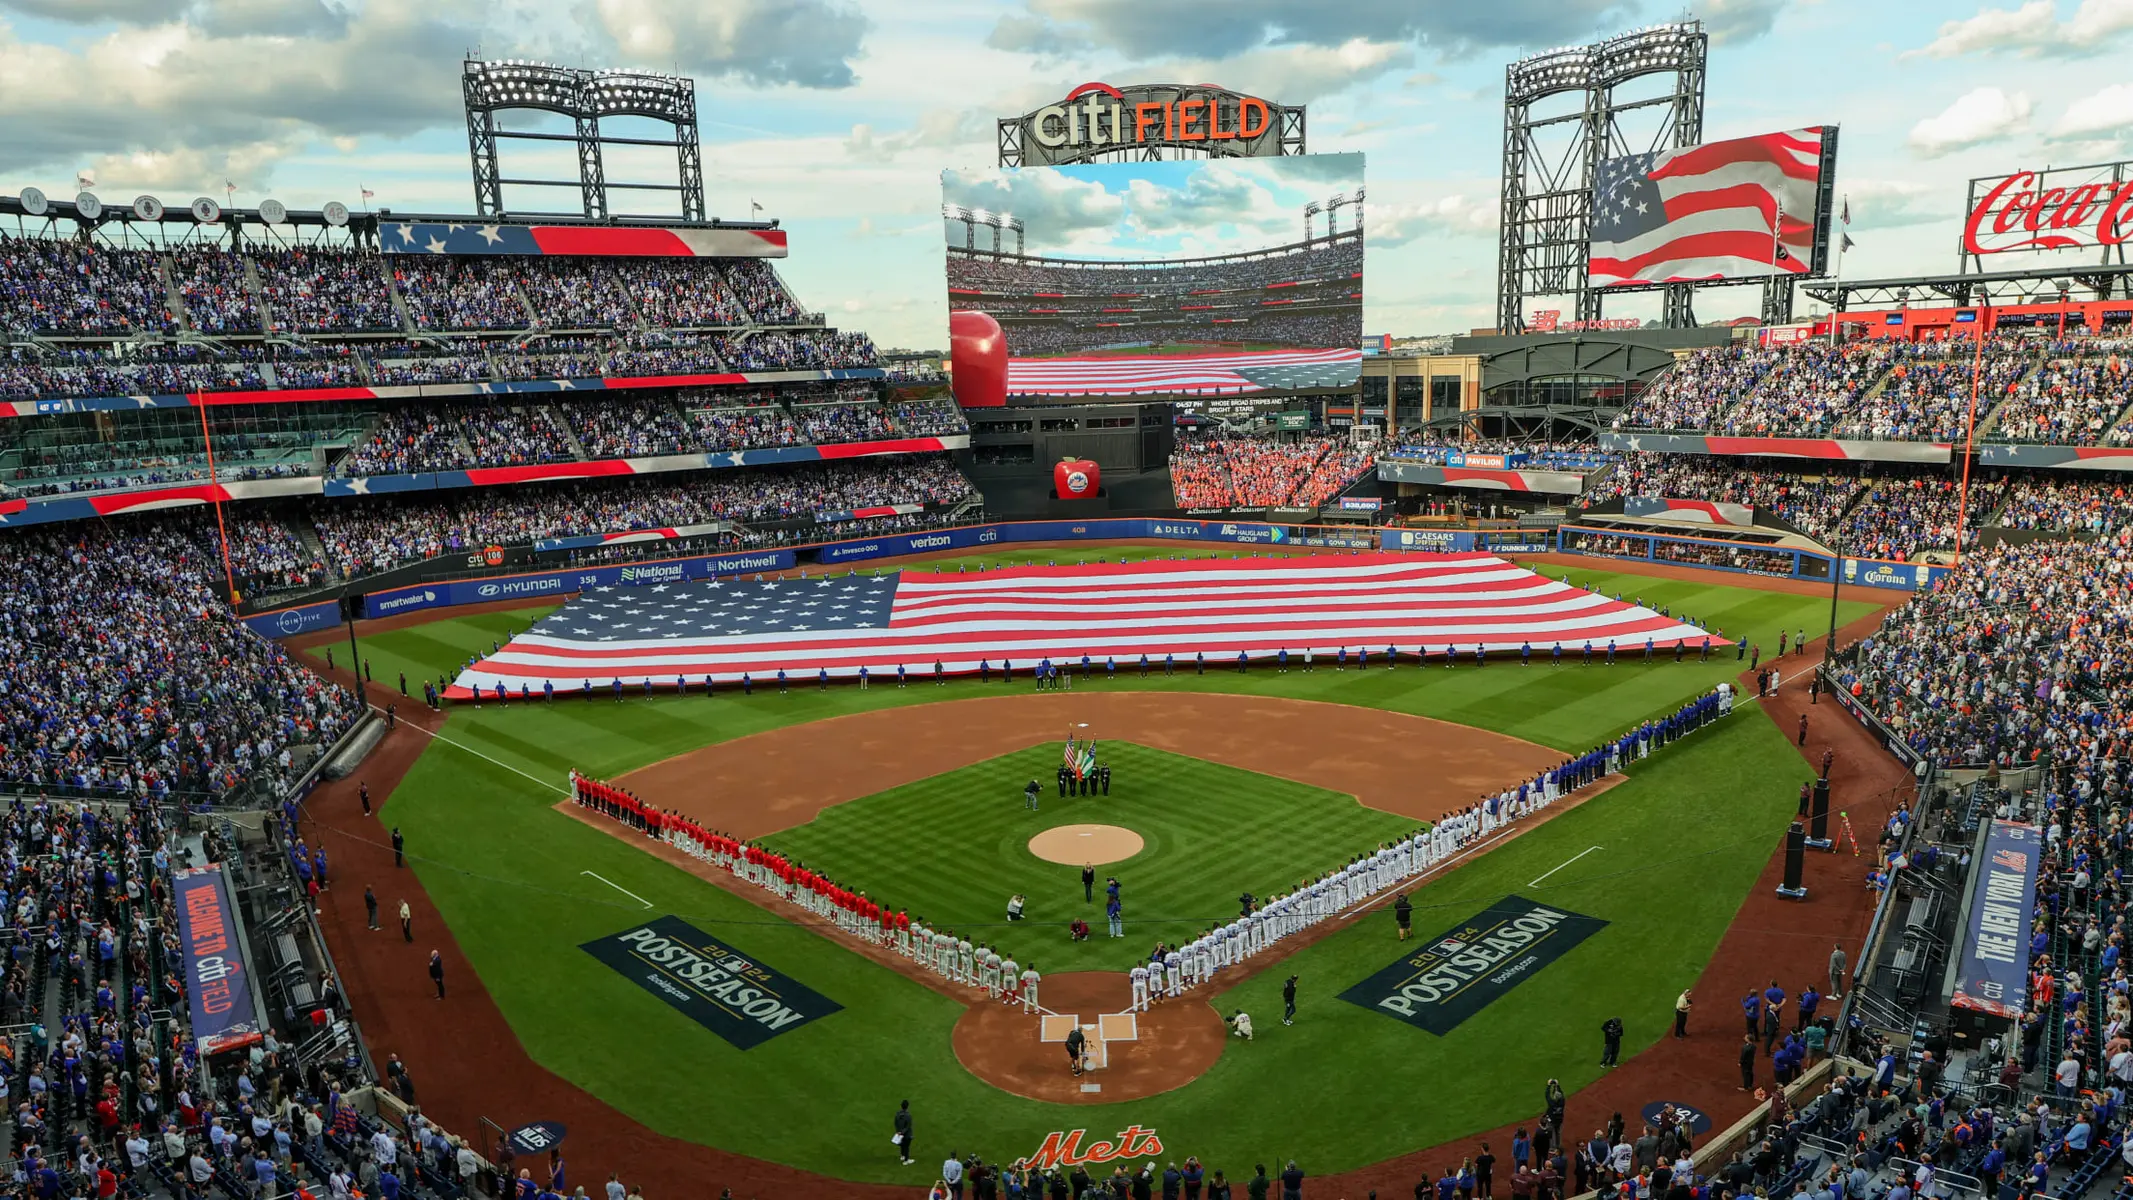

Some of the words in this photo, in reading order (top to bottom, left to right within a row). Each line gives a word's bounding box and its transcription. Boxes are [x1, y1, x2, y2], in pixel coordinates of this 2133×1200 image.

[1034, 93, 1121, 147] citi
[1135, 97, 1269, 143] FIELD
[27, 194, 40, 207] 14
[82, 199, 95, 211] 37
[262, 205, 283, 217] SHEA
[328, 207, 344, 219] 42
[1964, 171, 2133, 255] Coca-C
[1588, 317, 1640, 330] balance
[1450, 456, 1463, 464] citi
[1467, 457, 1501, 466] PAVILION
[979, 531, 997, 542] citi
[1165, 525, 1199, 535] DELTA
[1237, 529, 1269, 537] HAUGLAND
[1415, 532, 1454, 541] CAESARS
[911, 535, 951, 549] verizon
[1289, 537, 1301, 545] 380
[842, 546, 865, 555] Invesco
[1583, 551, 1616, 560] CADILLAC
[468, 554, 483, 563] citi
[718, 554, 777, 571] Northwell
[635, 564, 682, 579] National
[1747, 569, 1788, 579] CADILLAC
[1864, 570, 1906, 584] Corona
[503, 578, 561, 593] HYUNDAI
[580, 576, 597, 584] 358
[379, 594, 424, 610] smartwater
[1985, 870, 2025, 904] YORK
[185, 884, 225, 941] WELCOME
[1980, 904, 2021, 937] NEW
[193, 936, 228, 956] TO
[1409, 953, 1436, 968] 20
[1453, 926, 1480, 941] 24
[1975, 933, 2018, 963] THE
[196, 956, 232, 983] citi
[702, 944, 728, 959] 20
[744, 967, 772, 982] 24
[1377, 907, 1569, 1017] POSTSEASON
[1491, 954, 1539, 985] Booking.com
[618, 927, 804, 1030] POSTSEASON
[646, 974, 690, 1002] Booking.com
[201, 979, 233, 1015] FIELD
[1014, 1124, 1164, 1171] Mets
